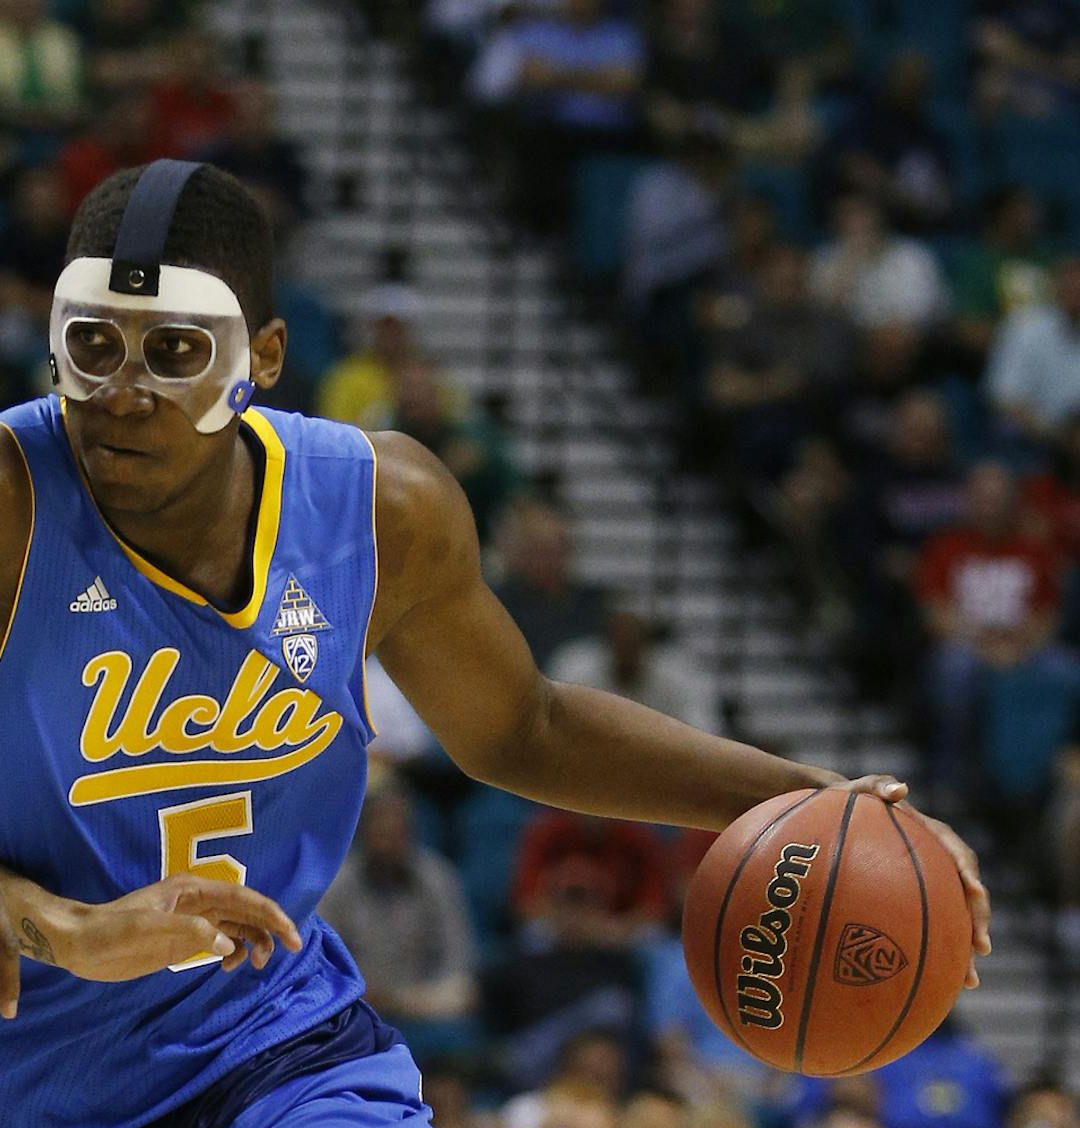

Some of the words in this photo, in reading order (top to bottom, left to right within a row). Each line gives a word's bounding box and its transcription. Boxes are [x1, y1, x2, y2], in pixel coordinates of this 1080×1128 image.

[69, 598, 118, 612] adidas
[277, 608, 315, 628] JRW
[285, 637, 316, 664] PAC
[294, 654, 311, 673] 12
[158, 790, 254, 973] 5
[736, 842, 820, 1031] Wilson
[838, 926, 884, 982] PAC
[873, 947, 896, 972] 12
